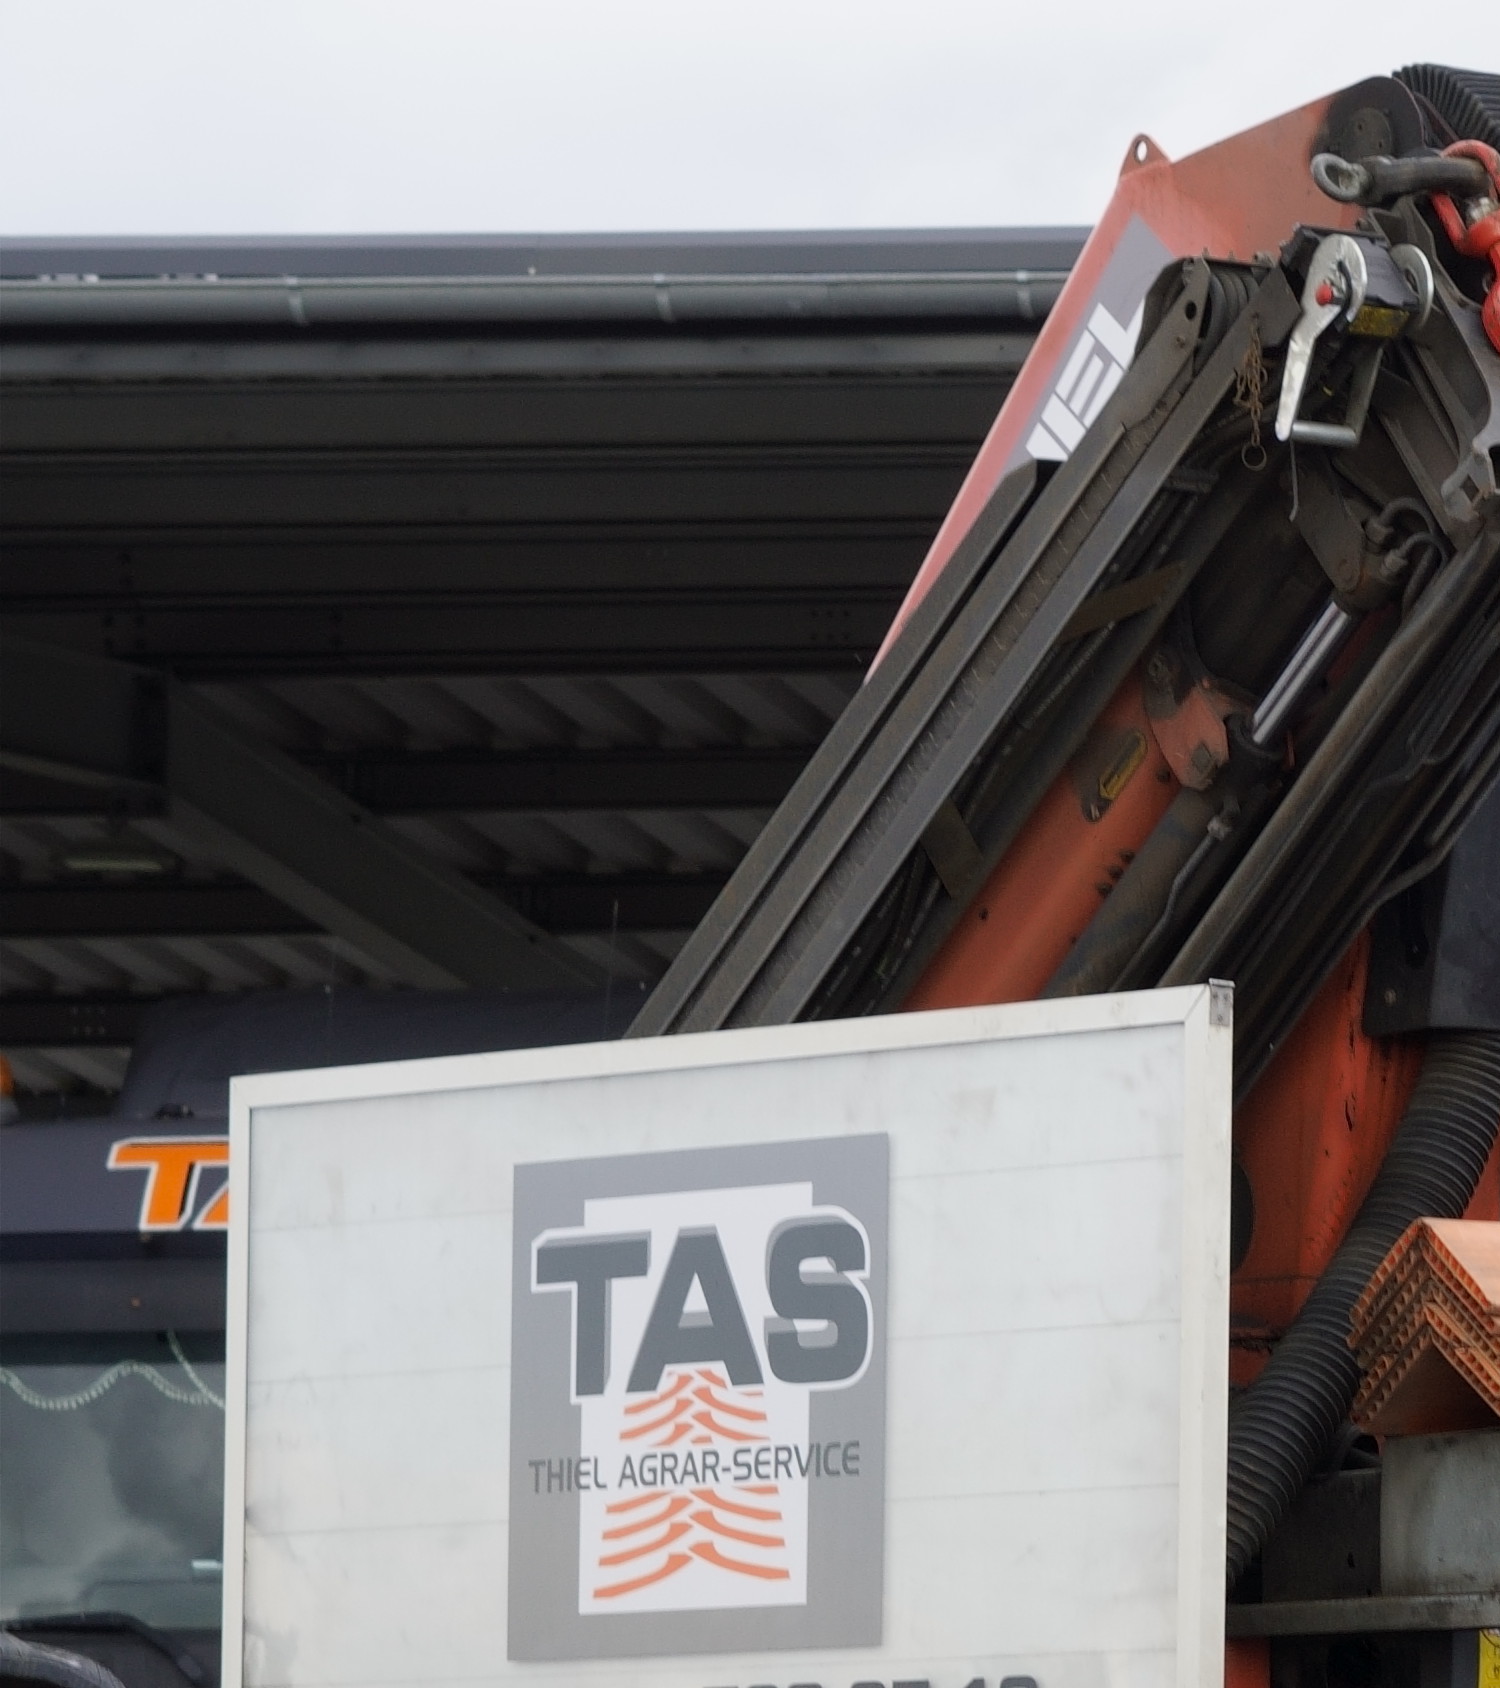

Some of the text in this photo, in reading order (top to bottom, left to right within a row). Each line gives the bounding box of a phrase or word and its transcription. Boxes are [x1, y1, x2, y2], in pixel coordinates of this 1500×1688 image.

[107, 1136, 230, 1231] T
[533, 1209, 871, 1398] TAS
[528, 1439, 861, 1493] THIEL AGRAR-SERVICE
